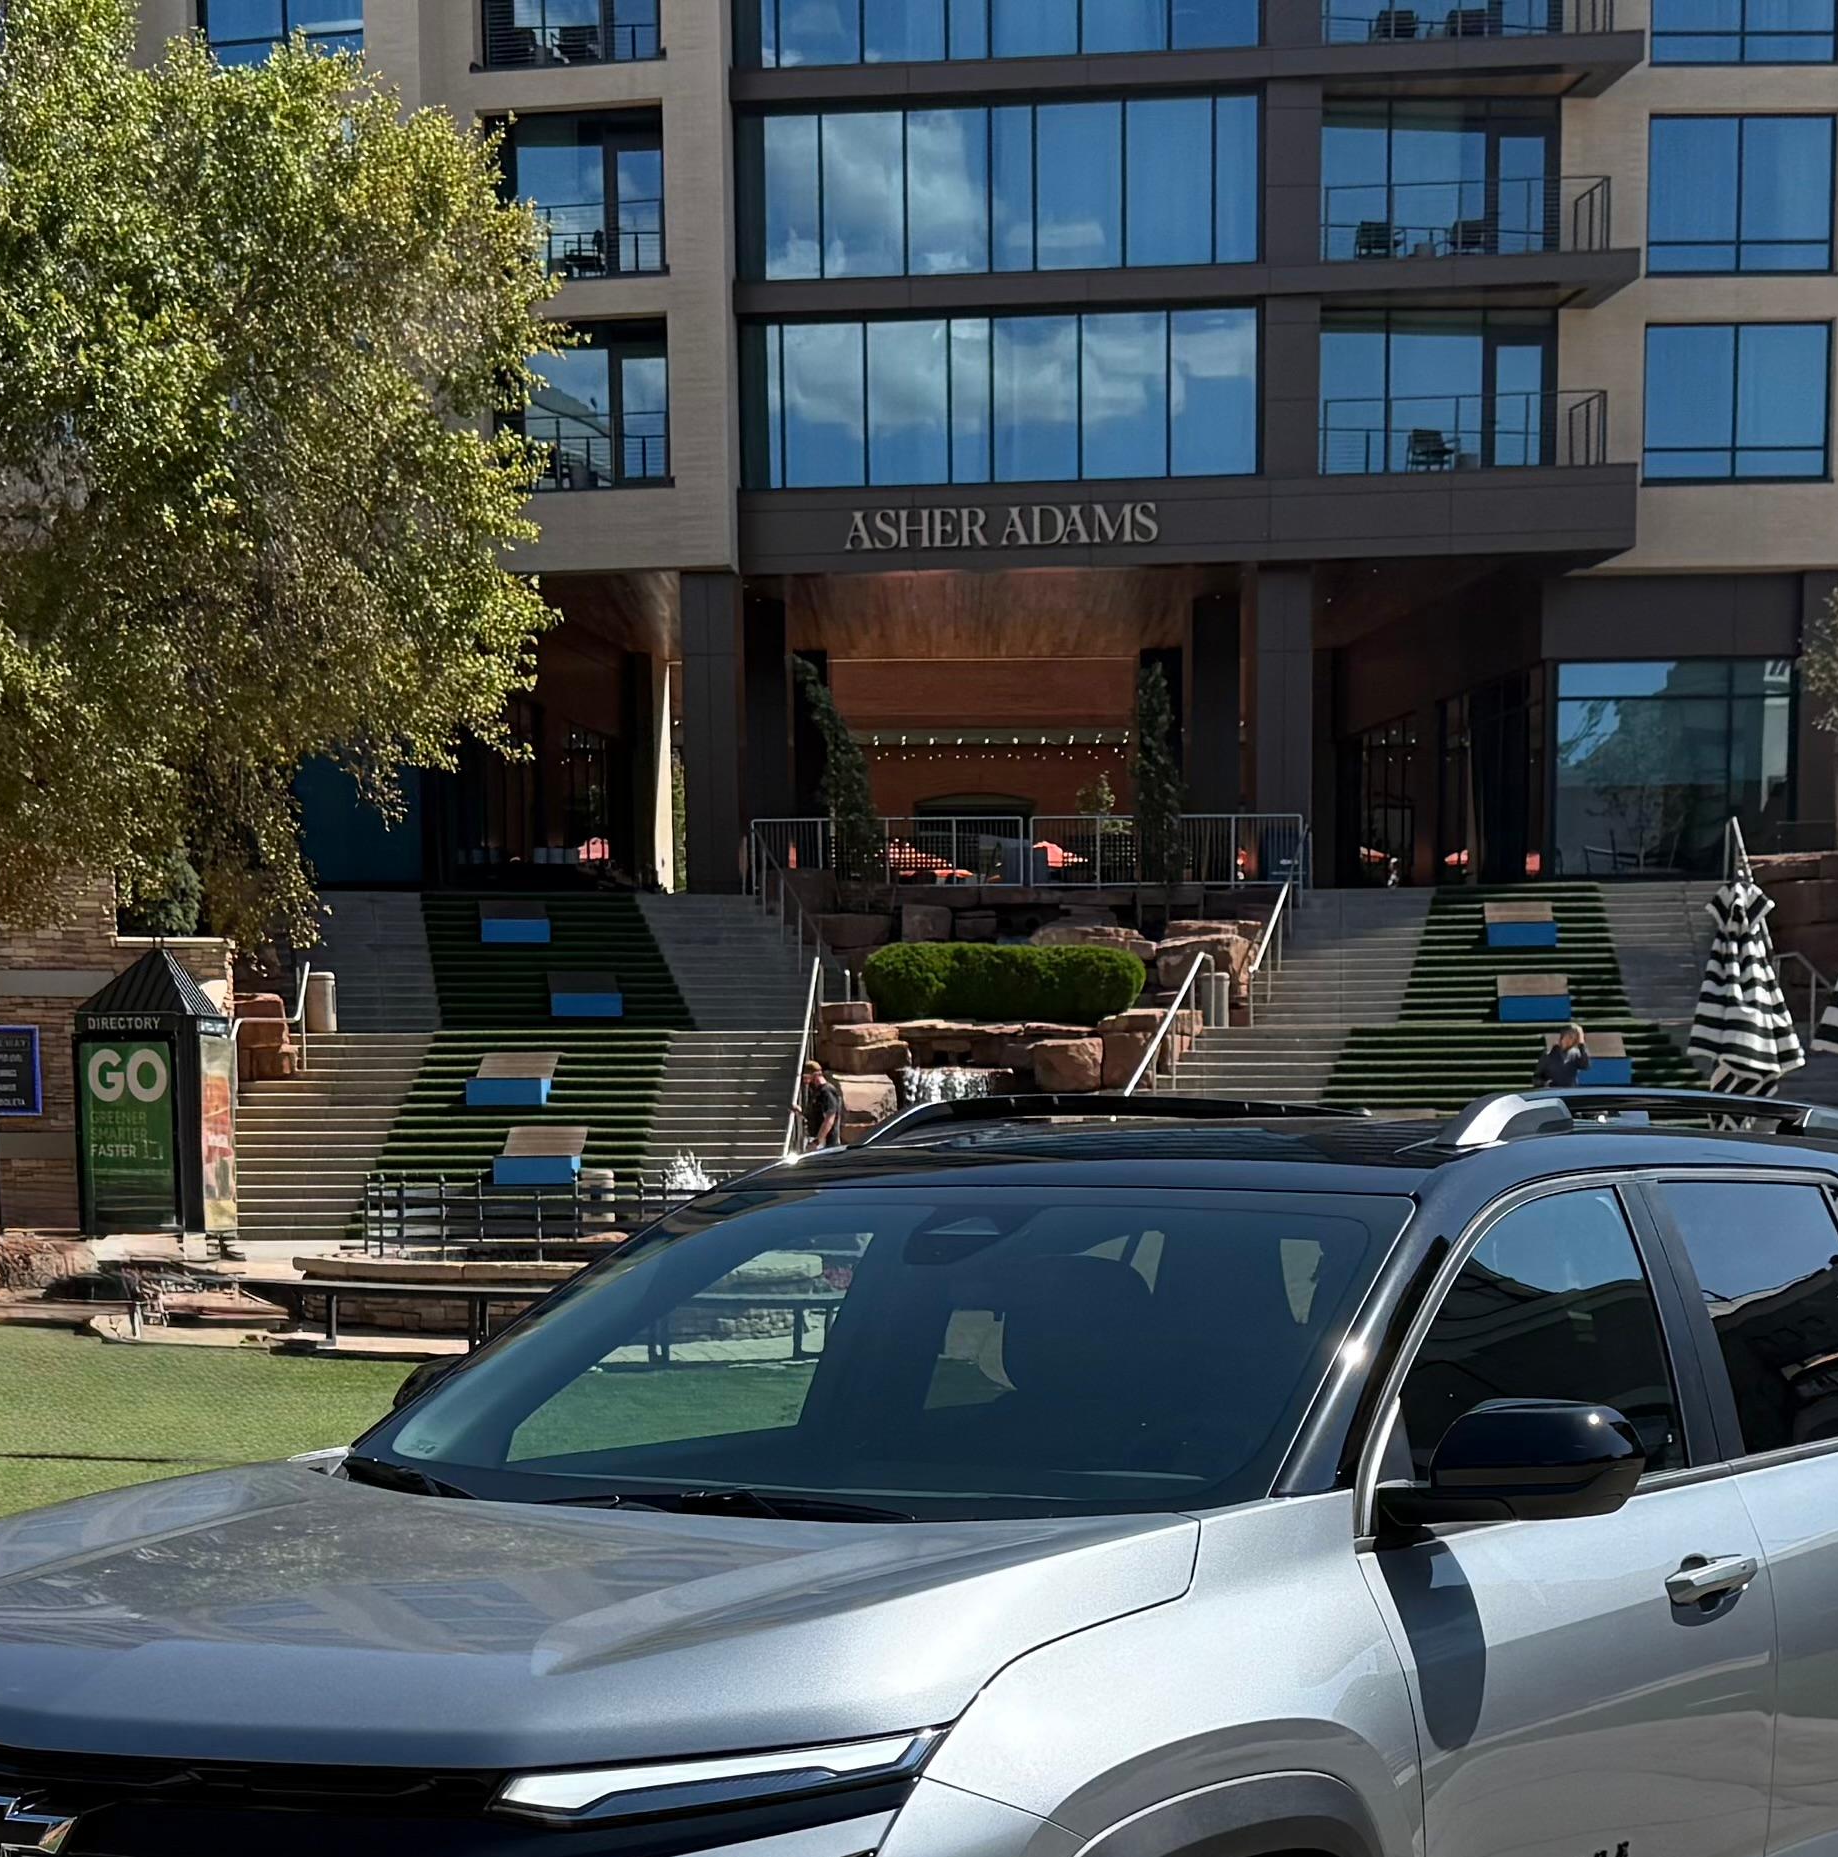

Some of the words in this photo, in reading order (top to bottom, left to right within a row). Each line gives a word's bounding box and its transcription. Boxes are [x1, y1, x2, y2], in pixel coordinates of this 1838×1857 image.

[844, 507, 989, 550] ASHER
[1001, 502, 1159, 546] ADAMS
[87, 1017, 161, 1030] DIRECTORY
[88, 1049, 167, 1102] GO
[90, 1110, 147, 1125] GREENER
[90, 1127, 148, 1142] SMARTER
[90, 1143, 136, 1158] FASTER
